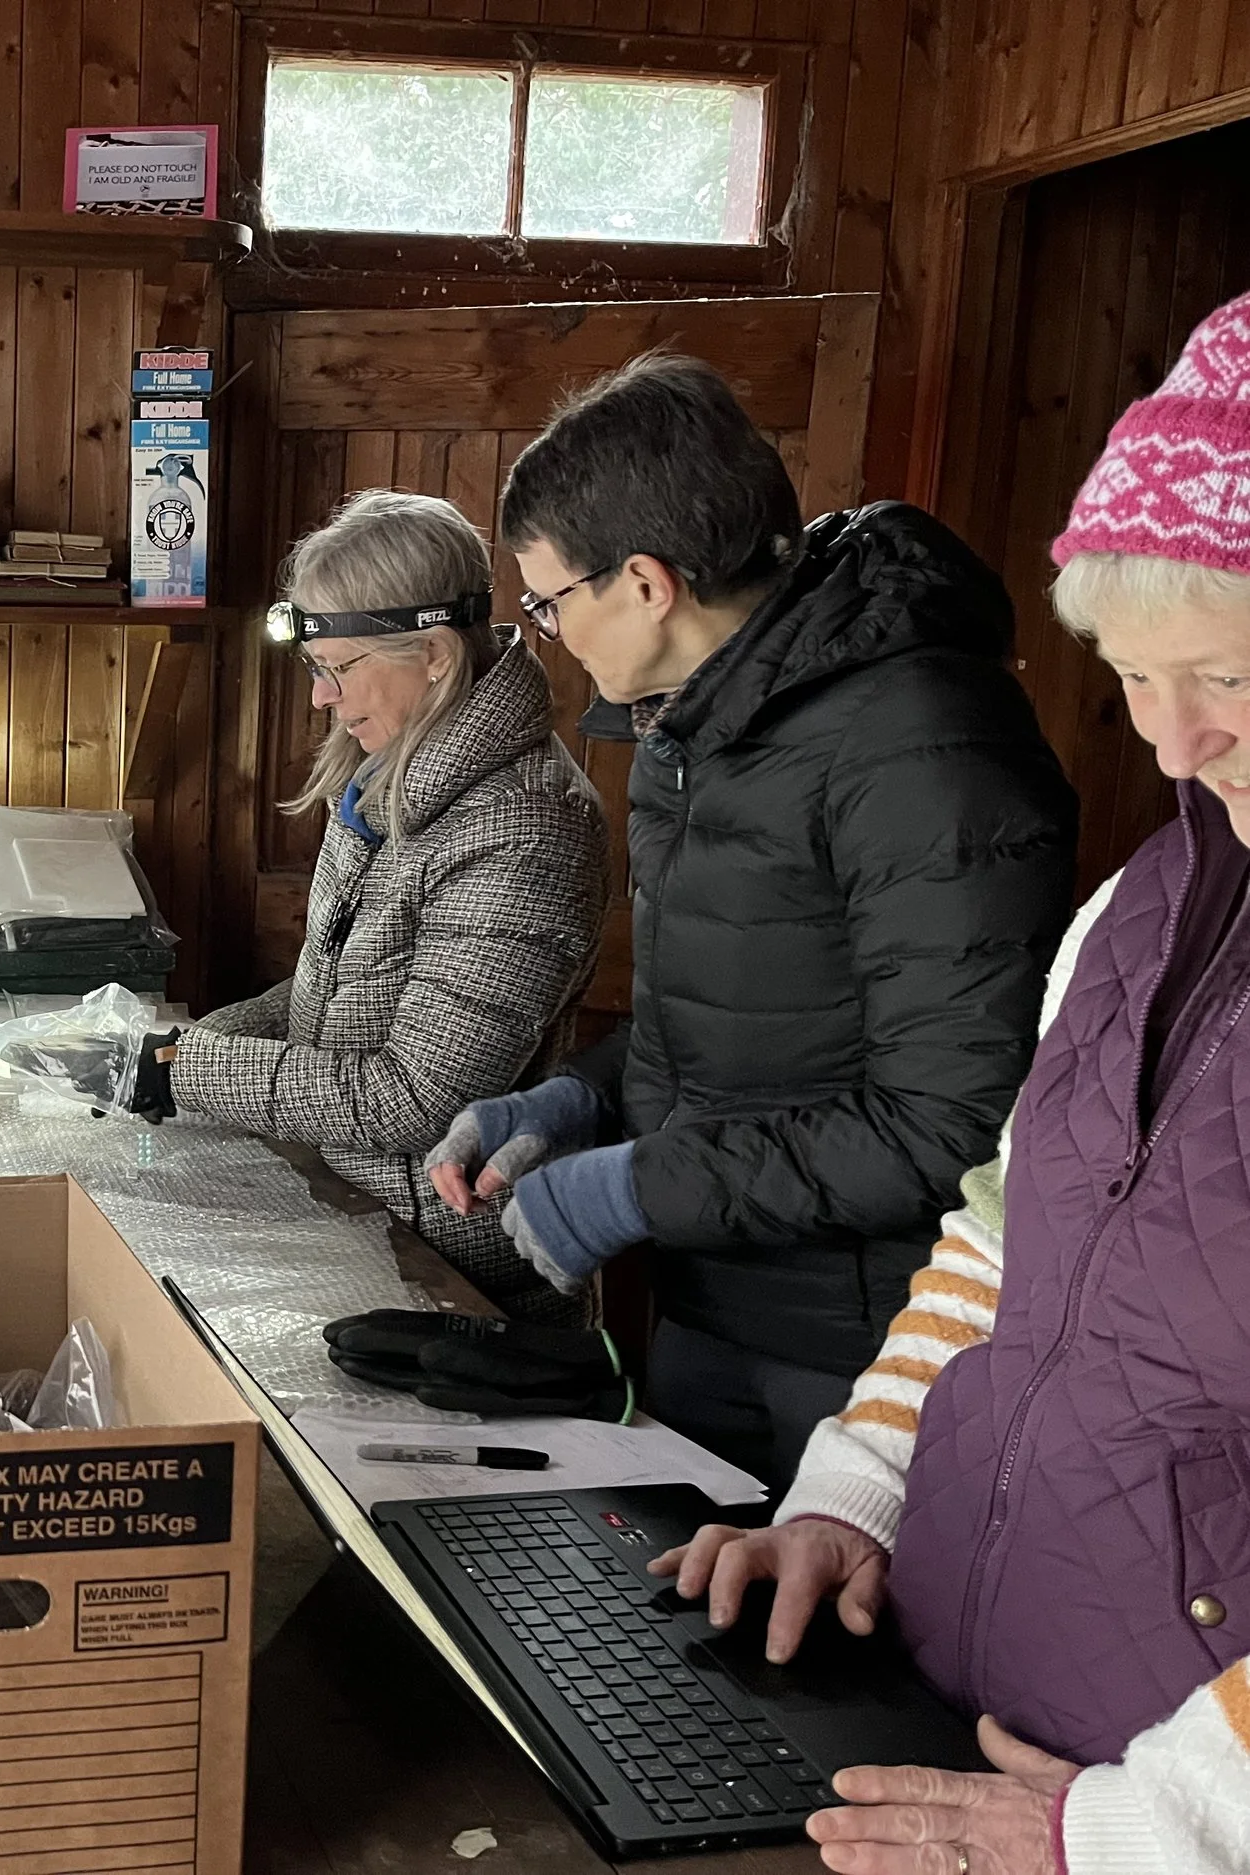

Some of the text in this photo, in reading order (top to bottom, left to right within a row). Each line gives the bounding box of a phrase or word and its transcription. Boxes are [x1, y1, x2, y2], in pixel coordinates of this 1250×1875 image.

[89, 163, 197, 174] PLEASE DO NOT TOUCH
[112, 176, 131, 184] OLD
[133, 175, 155, 183] AND
[140, 352, 209, 370] KIDDE
[153, 371, 192, 385] Full Home
[151, 423, 191, 438] Full Home
[418, 610, 451, 628] PETZL
[18, 1463, 70, 1485] MAY
[78, 1459, 179, 1483] CREATE
[186, 1459, 204, 1478] A
[38, 1488, 144, 1511] HAZARD
[13, 1516, 115, 1541] EXCEED
[123, 1513, 197, 1537] 15Kgs
[83, 1584, 169, 1601] WARNING!
[109, 1612, 134, 1621] MUST
[137, 1610, 173, 1620] ALWAYS
[81, 1619, 188, 1633] WHEN LIFTING THIS BOX
[81, 1635, 108, 1644] WHEN
